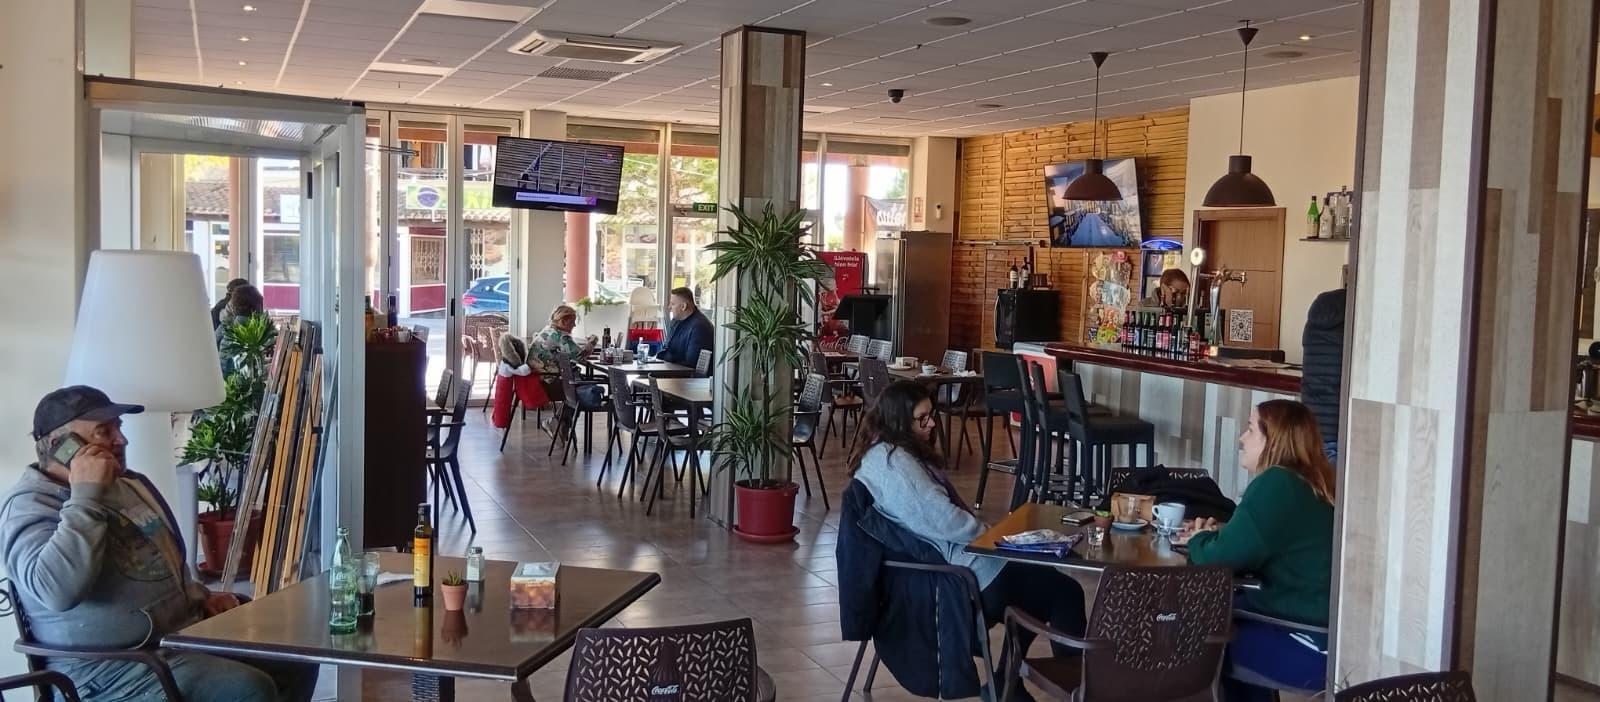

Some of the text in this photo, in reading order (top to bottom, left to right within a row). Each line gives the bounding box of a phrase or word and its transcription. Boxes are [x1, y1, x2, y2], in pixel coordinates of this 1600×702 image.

[698, 204, 715, 212] EXIT
[1156, 613, 1177, 622] Coca-Cola
[651, 684, 680, 696] Coca-Cola
